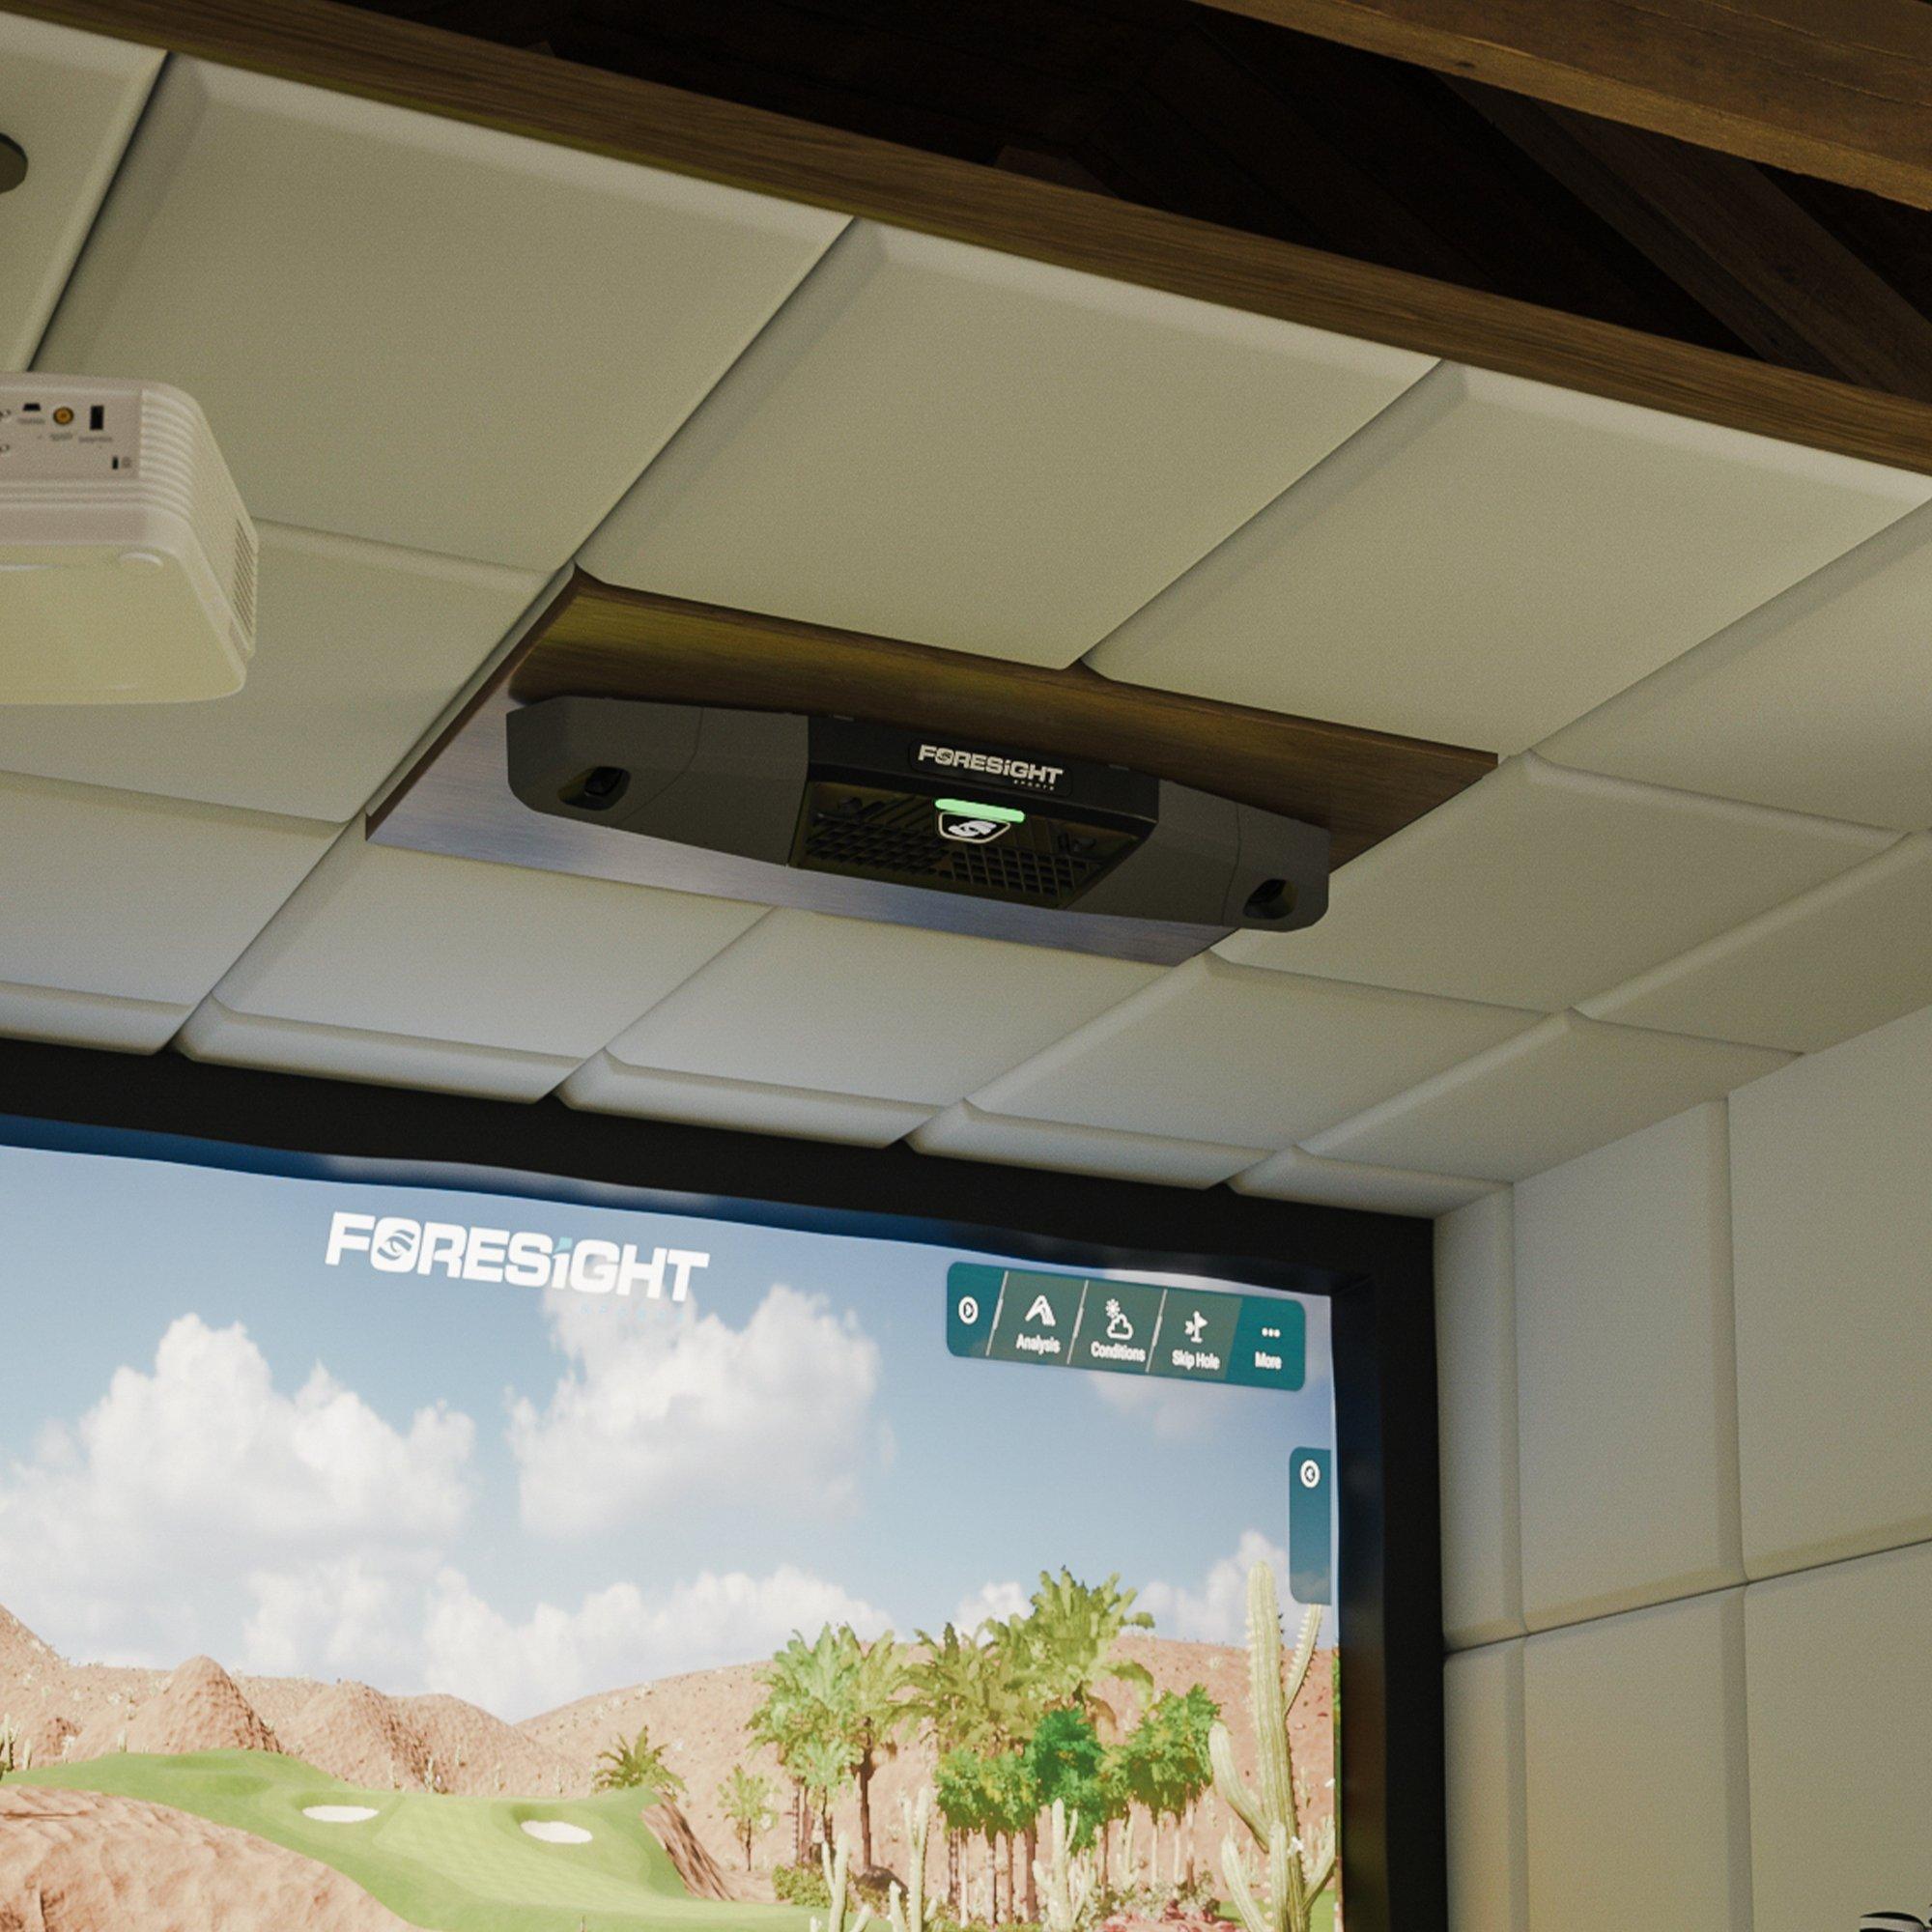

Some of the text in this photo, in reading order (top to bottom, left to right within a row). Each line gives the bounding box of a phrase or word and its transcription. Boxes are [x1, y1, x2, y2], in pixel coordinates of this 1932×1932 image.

[1015, 1333, 1061, 1354] Analysis
[1091, 1340, 1146, 1362] Conditions
[1172, 1350, 1220, 1371] Skip Hole
[1255, 1351, 1281, 1370] More
